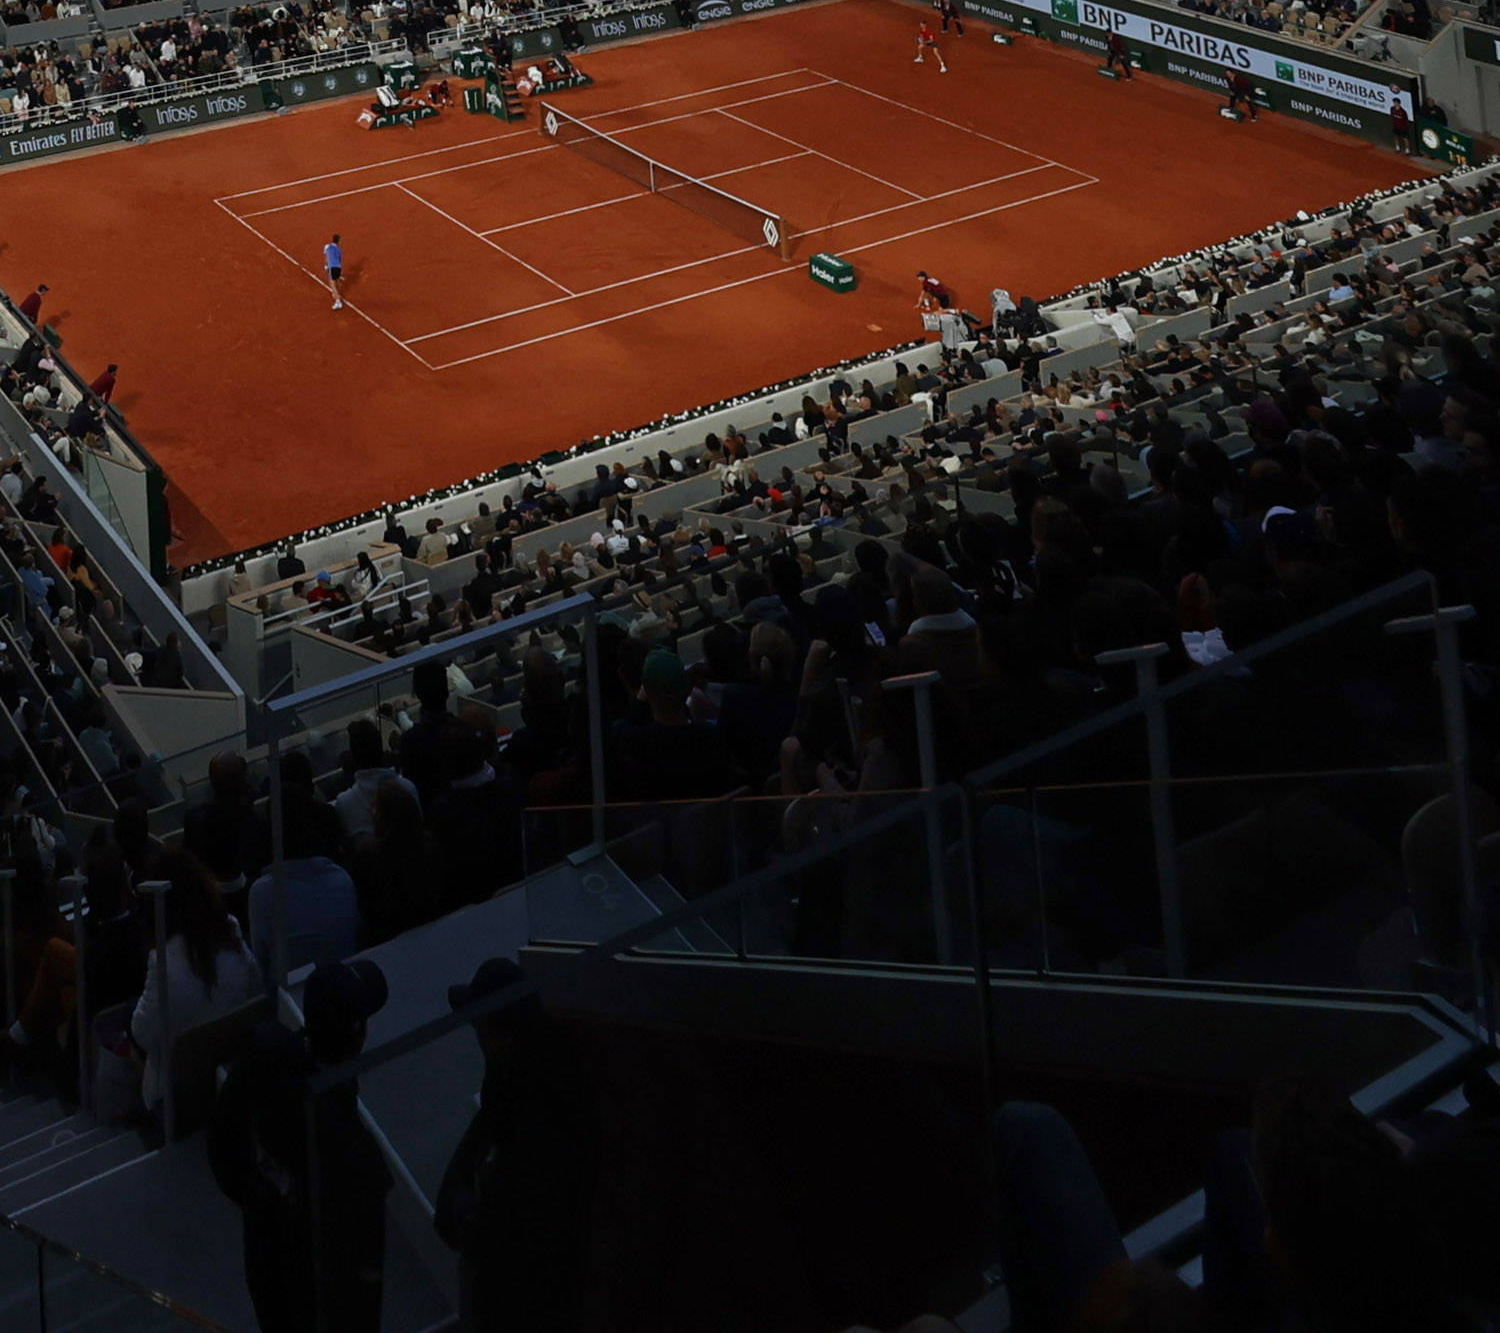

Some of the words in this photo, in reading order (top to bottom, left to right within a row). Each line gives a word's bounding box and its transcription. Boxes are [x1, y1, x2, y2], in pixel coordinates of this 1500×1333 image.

[632, 12, 667, 30] Infosys
[964, 0, 981, 13] BNP
[981, 5, 1014, 22] PARIBAS
[592, 20, 627, 38] Infosys
[1060, 30, 1078, 45] BNP
[1083, 3, 1127, 30] BNP
[1150, 23, 1251, 69] PARIBAS
[1167, 61, 1188, 77] BNP
[1298, 68, 1325, 84] BNP
[1328, 77, 1385, 103] PARIBAS
[156, 104, 198, 126] Infosys
[205, 94, 247, 116] Infosys
[1290, 99, 1314, 114] BNP
[1315, 106, 1363, 130] PARIBAS
[10, 133, 67, 156] Emirates
[70, 127, 85, 144] FLY
[85, 121, 115, 140] BETTER
